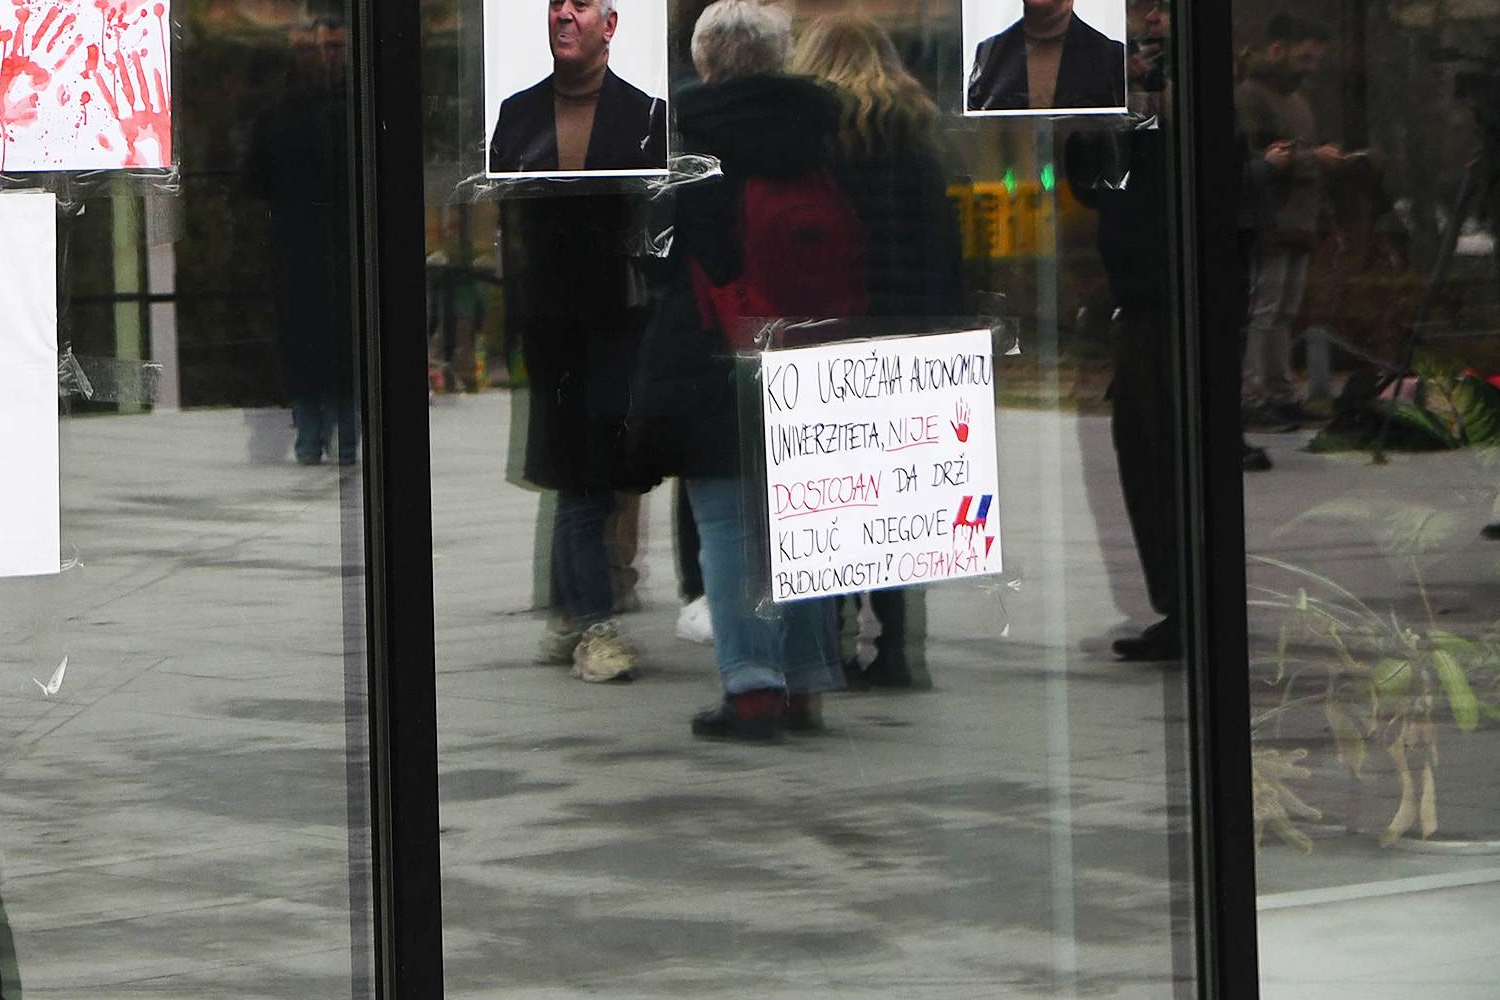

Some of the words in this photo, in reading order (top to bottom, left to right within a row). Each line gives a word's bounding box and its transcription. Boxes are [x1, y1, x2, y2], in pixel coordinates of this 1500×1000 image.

[766, 363, 799, 414] KO
[817, 349, 902, 405] UGROŽAVA
[909, 353, 994, 394] AUTONOMIJU
[770, 421, 885, 466] UNIVERZITETA,
[888, 415, 939, 445] NIJE
[772, 470, 882, 515] DOSTOJAN
[893, 464, 917, 493] DA
[932, 453, 970, 487] DRŽI
[778, 517, 841, 563] KLJUČ
[863, 509, 948, 545] NJEGOVE
